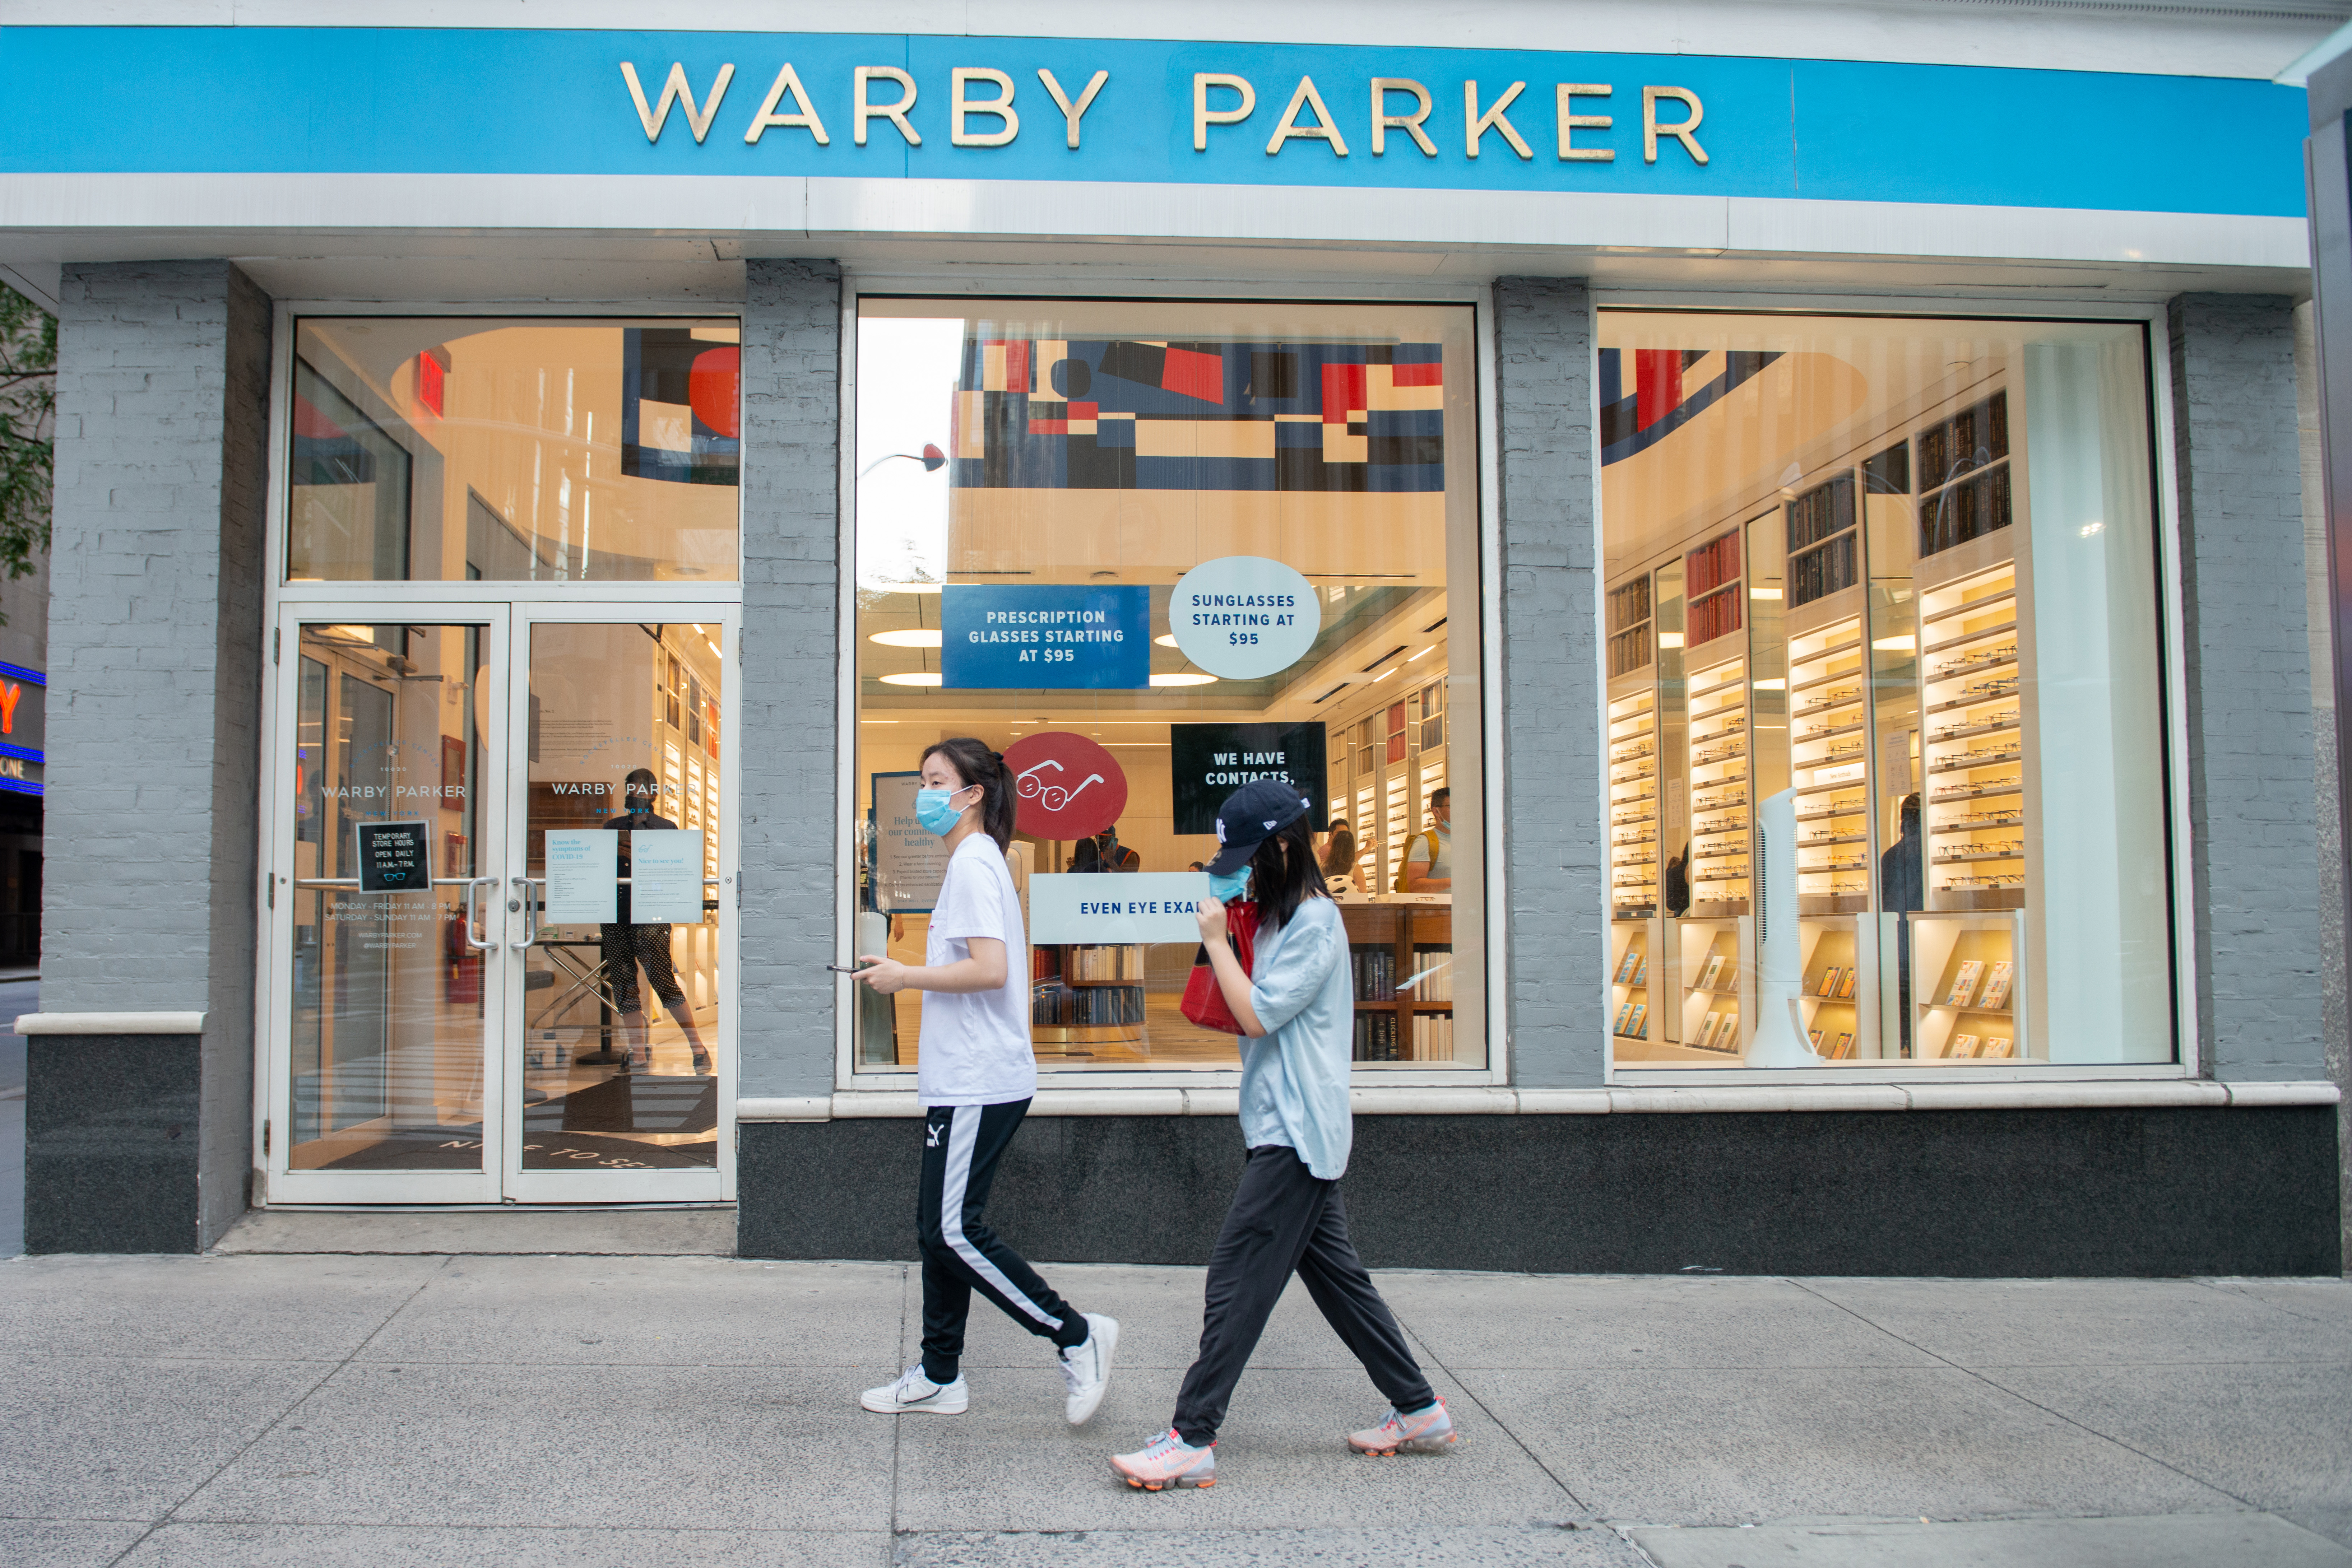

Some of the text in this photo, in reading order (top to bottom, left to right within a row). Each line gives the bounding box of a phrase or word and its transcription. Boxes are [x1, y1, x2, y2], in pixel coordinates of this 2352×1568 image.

[621, 60, 1710, 167] WARBY PARKER
[1192, 595, 1294, 607] SUNGLASSES
[987, 610, 1105, 624] PRESCRIPTION
[1192, 614, 1294, 626] STARTING AT
[969, 630, 1123, 643] GLASSES STARTING
[1229, 632, 1258, 646] $95
[1019, 649, 1074, 663] AT $95
[349, 739, 439, 768] ROCKEFELLER CENTER
[579, 736, 637, 765] ROCKEFELLER
[1214, 752, 1285, 765] WE HAVE
[1205, 771, 1295, 785] CONTACTS,
[322, 786, 466, 798] WARBY PARKER
[552, 783, 698, 795] WARBY PARKER
[894, 816, 913, 827] Help
[904, 837, 935, 848] healthy
[1081, 902, 1200, 914] EVEN EYE EXA
[439, 1141, 656, 1168] NIE TO SE
